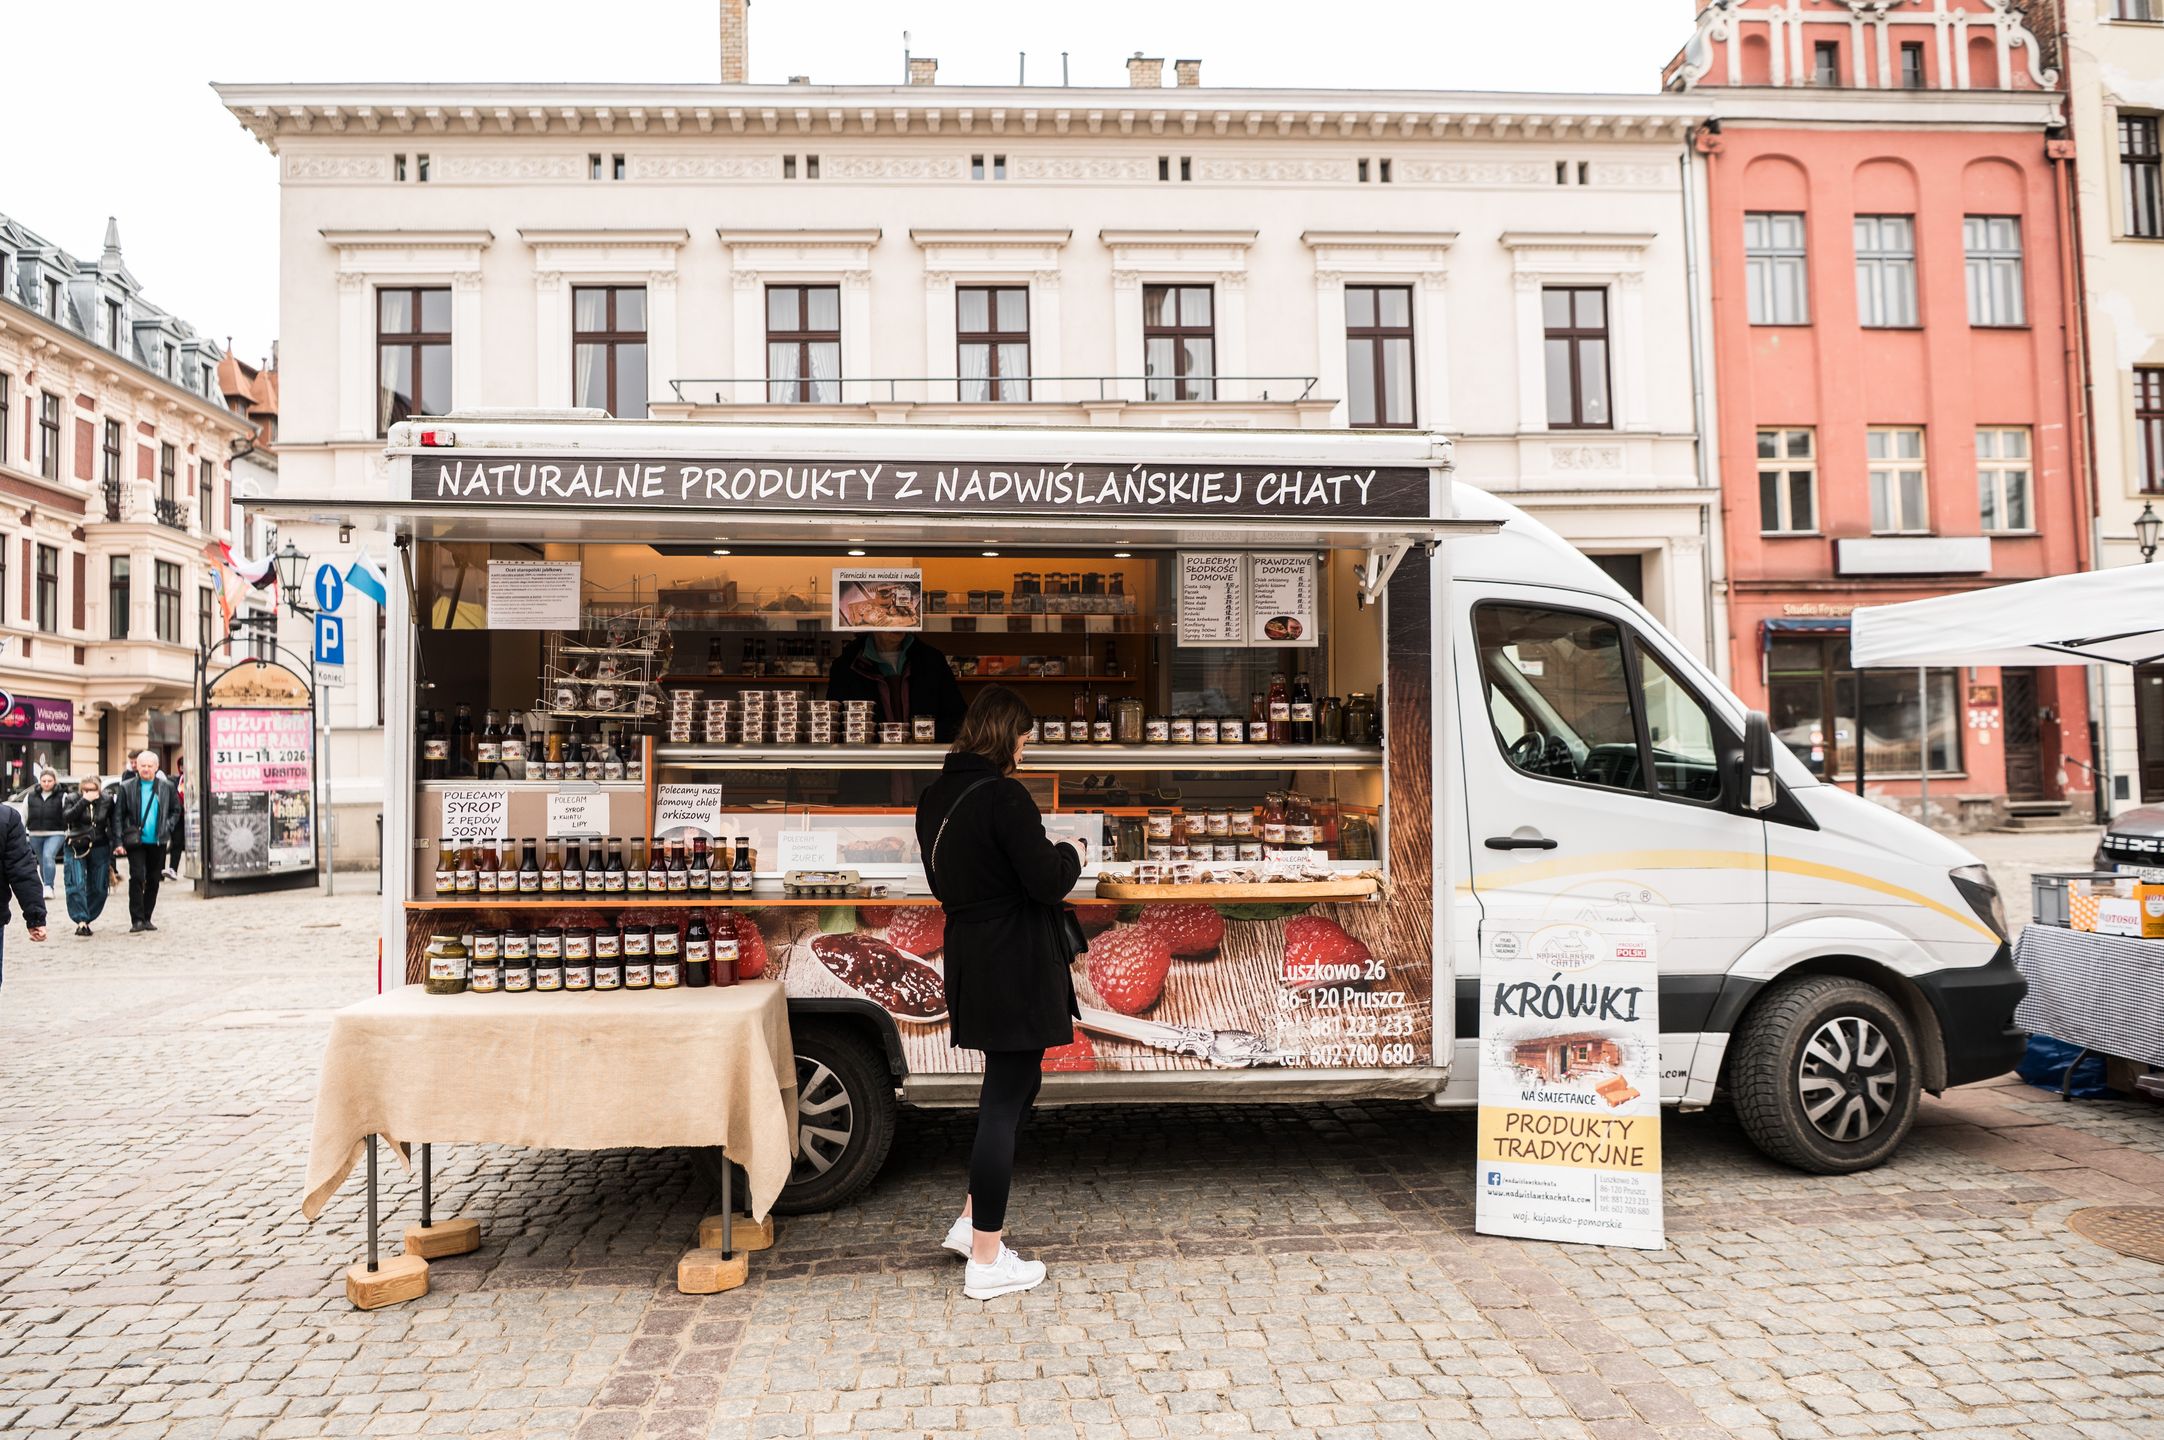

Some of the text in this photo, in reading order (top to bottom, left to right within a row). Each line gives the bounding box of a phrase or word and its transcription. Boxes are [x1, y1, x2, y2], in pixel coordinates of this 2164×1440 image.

[437, 461, 1376, 505] NATURALNE PRODUKTY Z NADWIŚLAŃSKIEJ CHATY
[1186, 565, 1238, 573] SŁODKOŚCI
[1262, 566, 1305, 574] DOMOWE
[321, 618, 339, 658] P
[318, 670, 342, 682] Koniec
[37, 707, 69, 721] Wszystko
[34, 720, 71, 733] dla włosów
[444, 791, 506, 800] POLECAMY
[659, 785, 721, 797] Polecamy nasz
[447, 802, 502, 814] SYROP
[657, 797, 718, 809] domowy chleb
[447, 814, 502, 826] Z PĘDÓW
[662, 809, 711, 823] orkiszowy
[451, 826, 498, 837] SOSNY
[572, 821, 588, 829] LIPY
[1616, 949, 1647, 958] POLSKI
[1279, 958, 1386, 981] Luszkowo 26
[1277, 986, 1406, 1009] 86-120 Pruszcz
[1493, 972, 1643, 1022] KRÓWKI
[1346, 1015, 1377, 1037] 223
[1382, 1015, 1414, 1037] 233
[1347, 1043, 1378, 1065] 700
[1381, 1043, 1414, 1065] 680
[1521, 1088, 1597, 1106] NA ŚMIETANCE
[1506, 1112, 1634, 1140] PRODUKTY
[1493, 1137, 1644, 1167] TRADYCYJNE
[1512, 1212, 1622, 1229] woj. kujawsko-pomorskie
